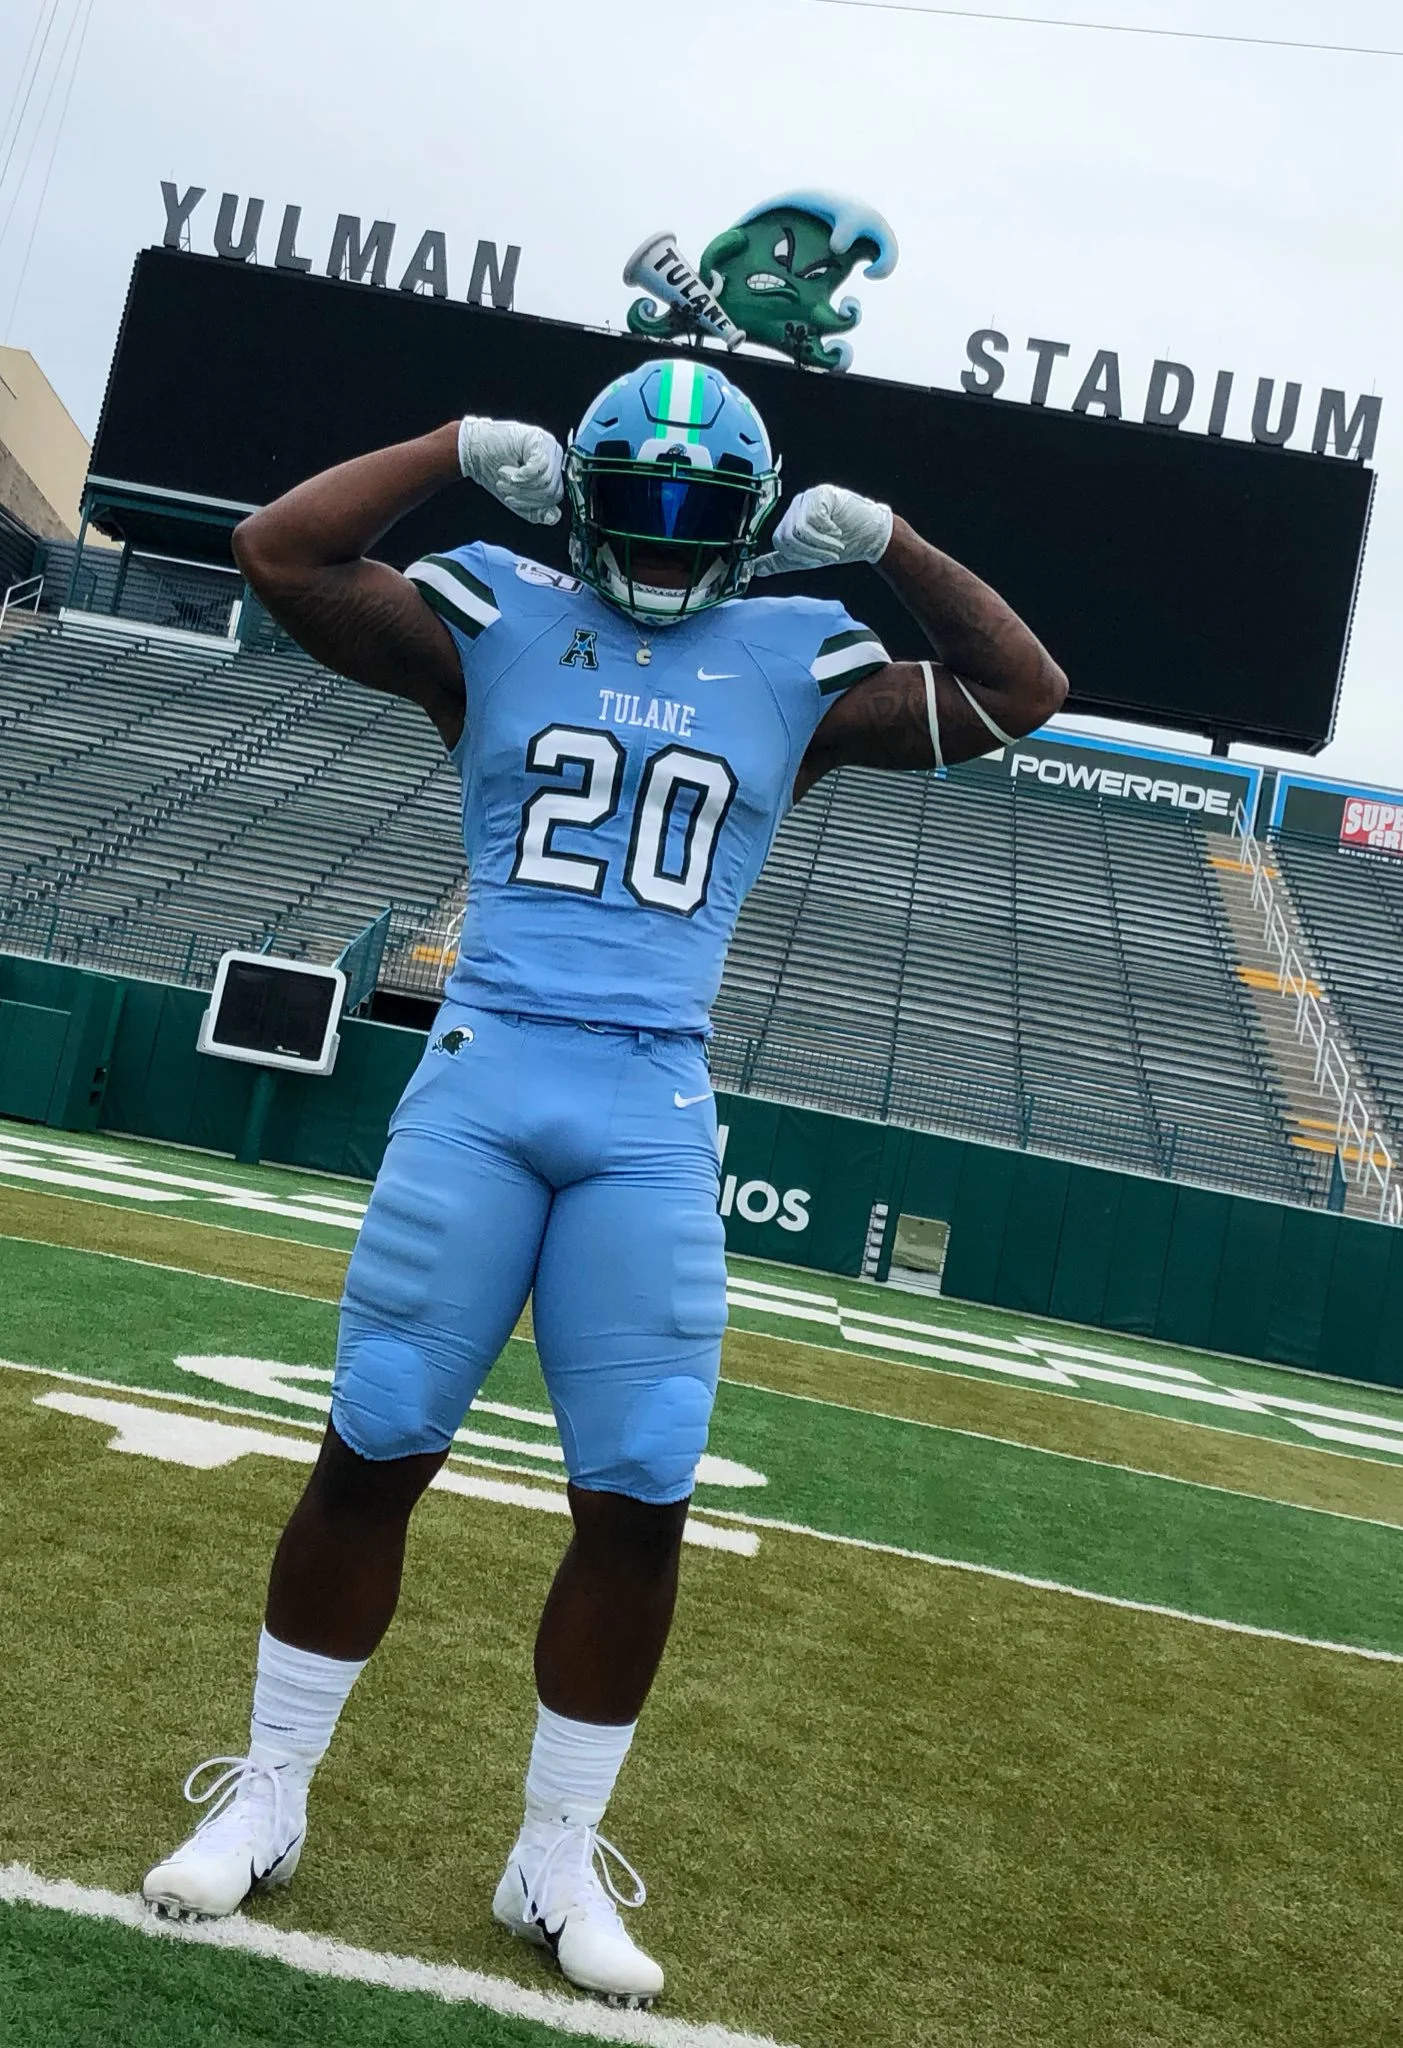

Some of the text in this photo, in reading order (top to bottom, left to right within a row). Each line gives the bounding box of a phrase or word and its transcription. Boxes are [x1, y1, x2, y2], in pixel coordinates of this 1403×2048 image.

[160, 180, 522, 309] YULMAN
[653, 247, 732, 331] TULANE
[960, 329, 1383, 461] STADIUM
[598, 689, 696, 737] TULANE
[507, 723, 739, 918] 20
[1010, 753, 1232, 817] POWERADE
